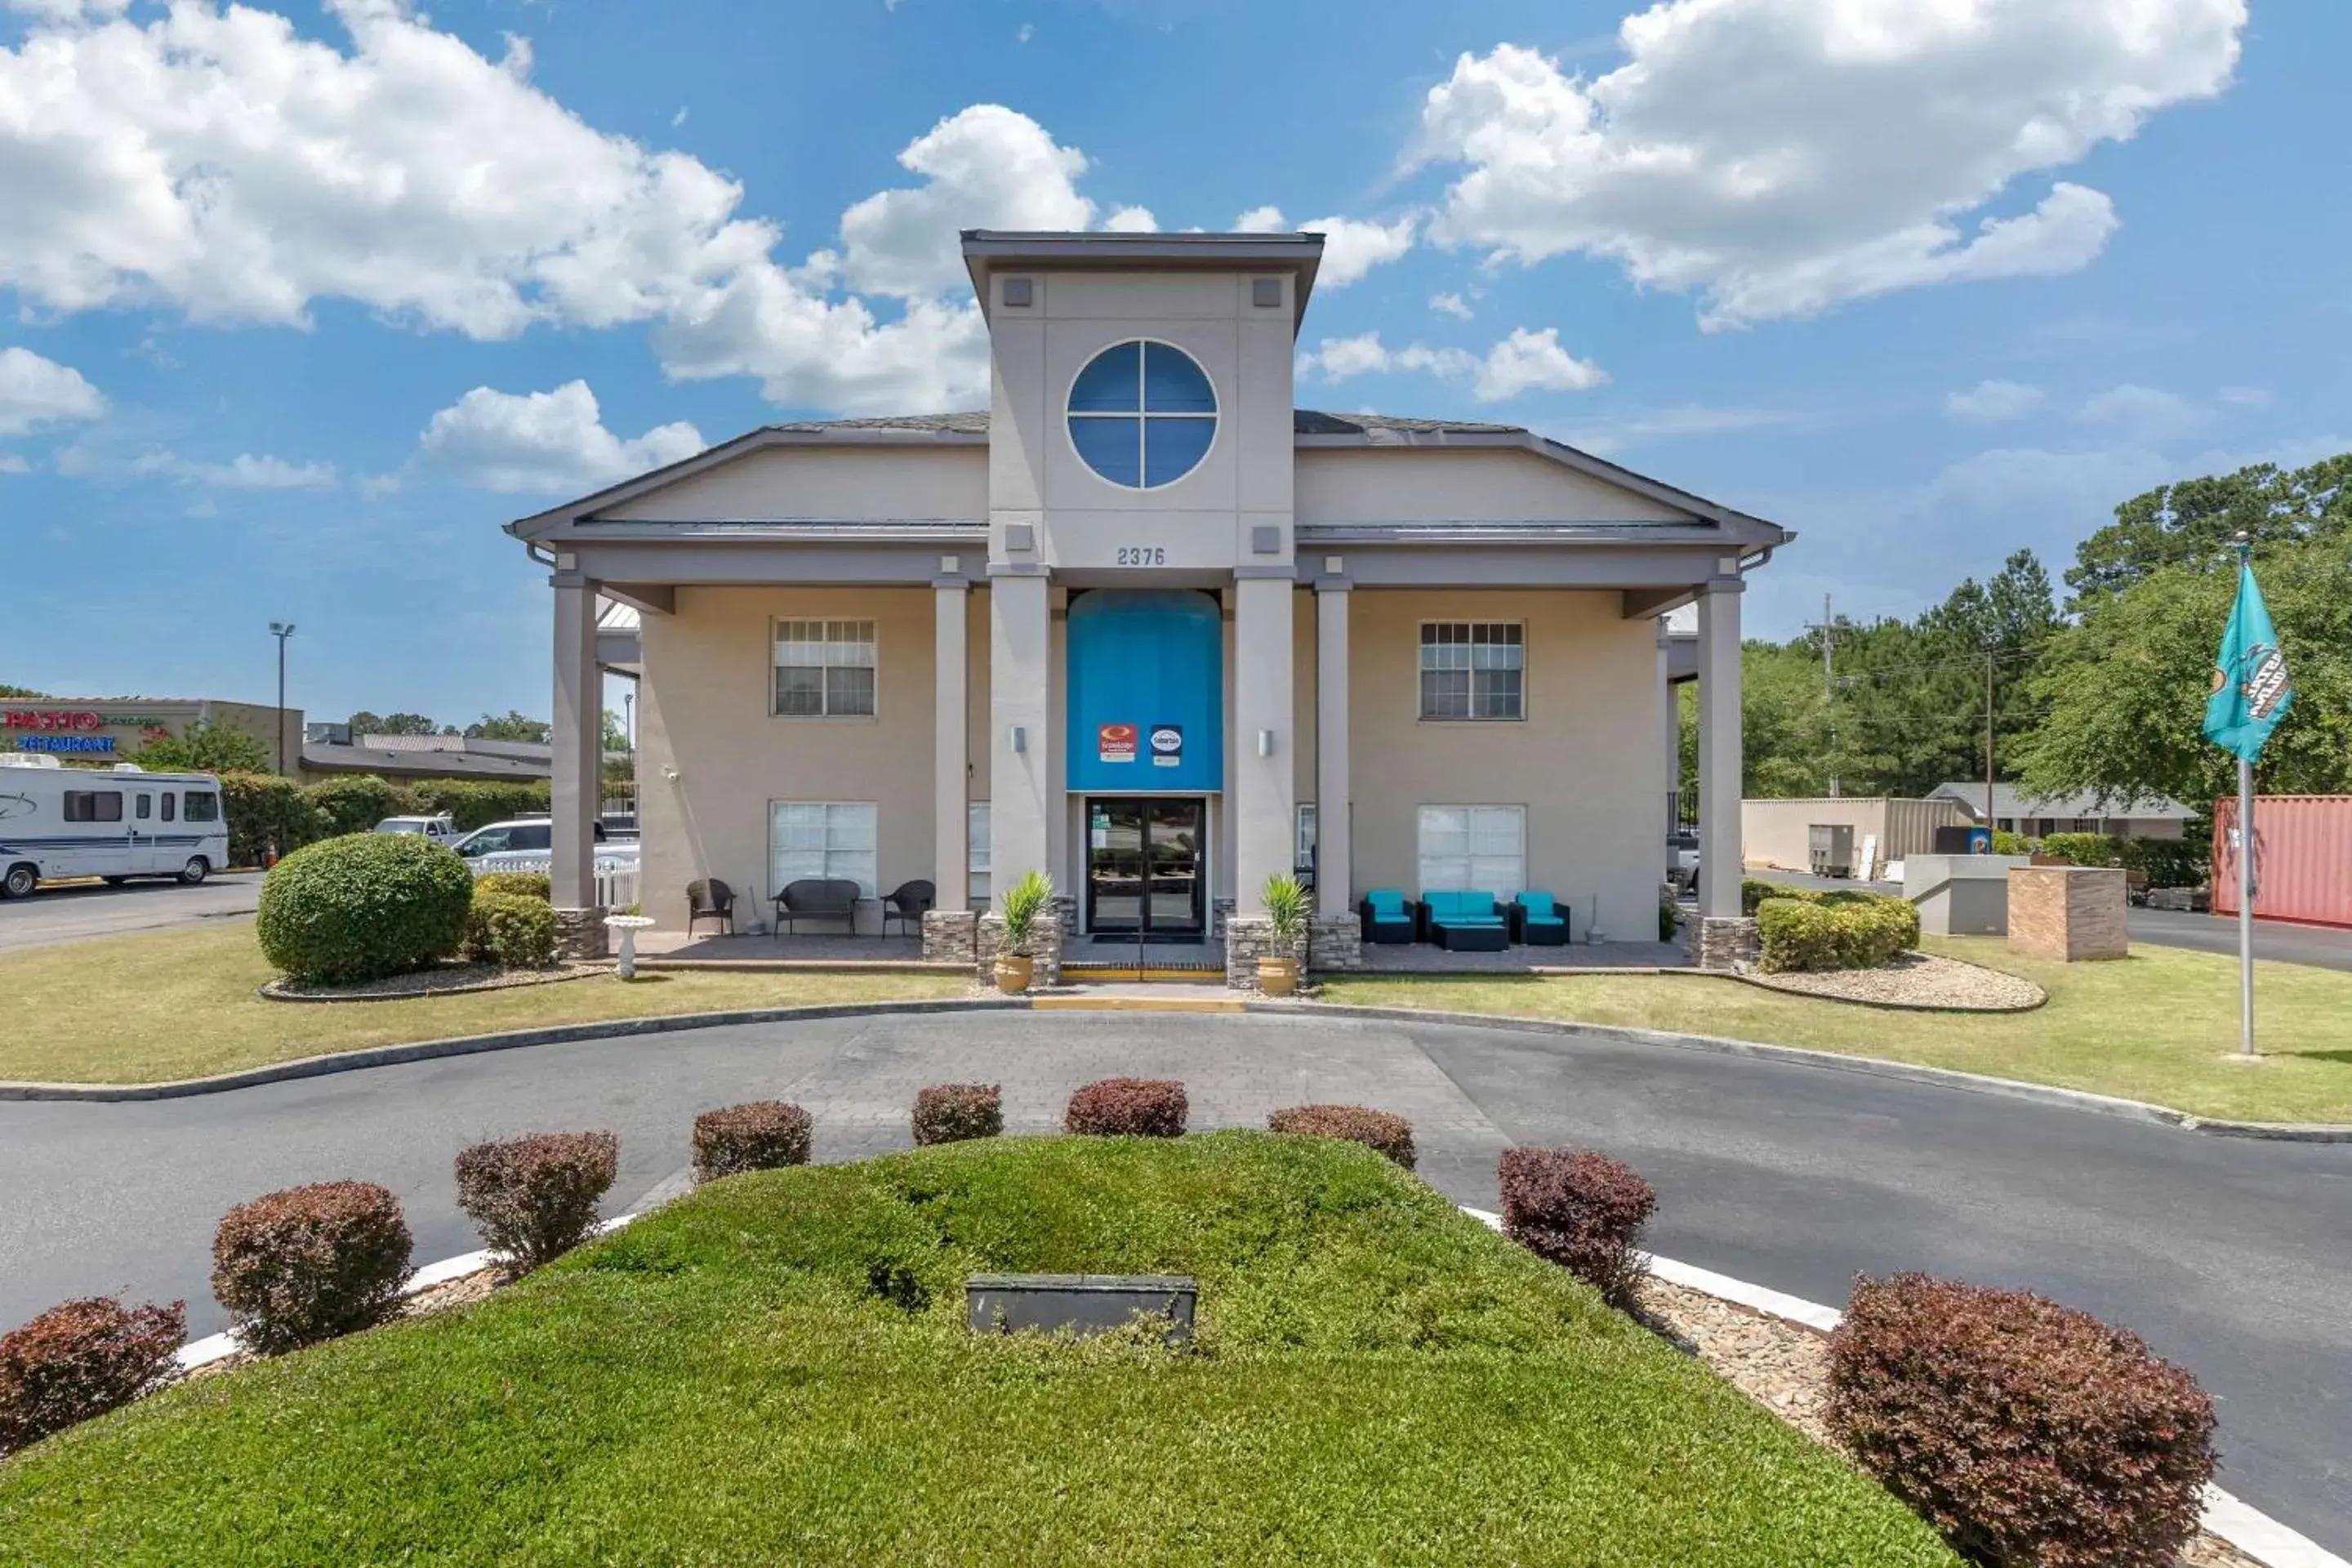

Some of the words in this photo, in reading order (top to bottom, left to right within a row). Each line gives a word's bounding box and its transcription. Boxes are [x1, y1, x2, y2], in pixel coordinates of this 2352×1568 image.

[1117, 547, 1165, 565] 2376
[3, 710, 98, 730] PATIO
[18, 735, 115, 751] RESTAURANT
